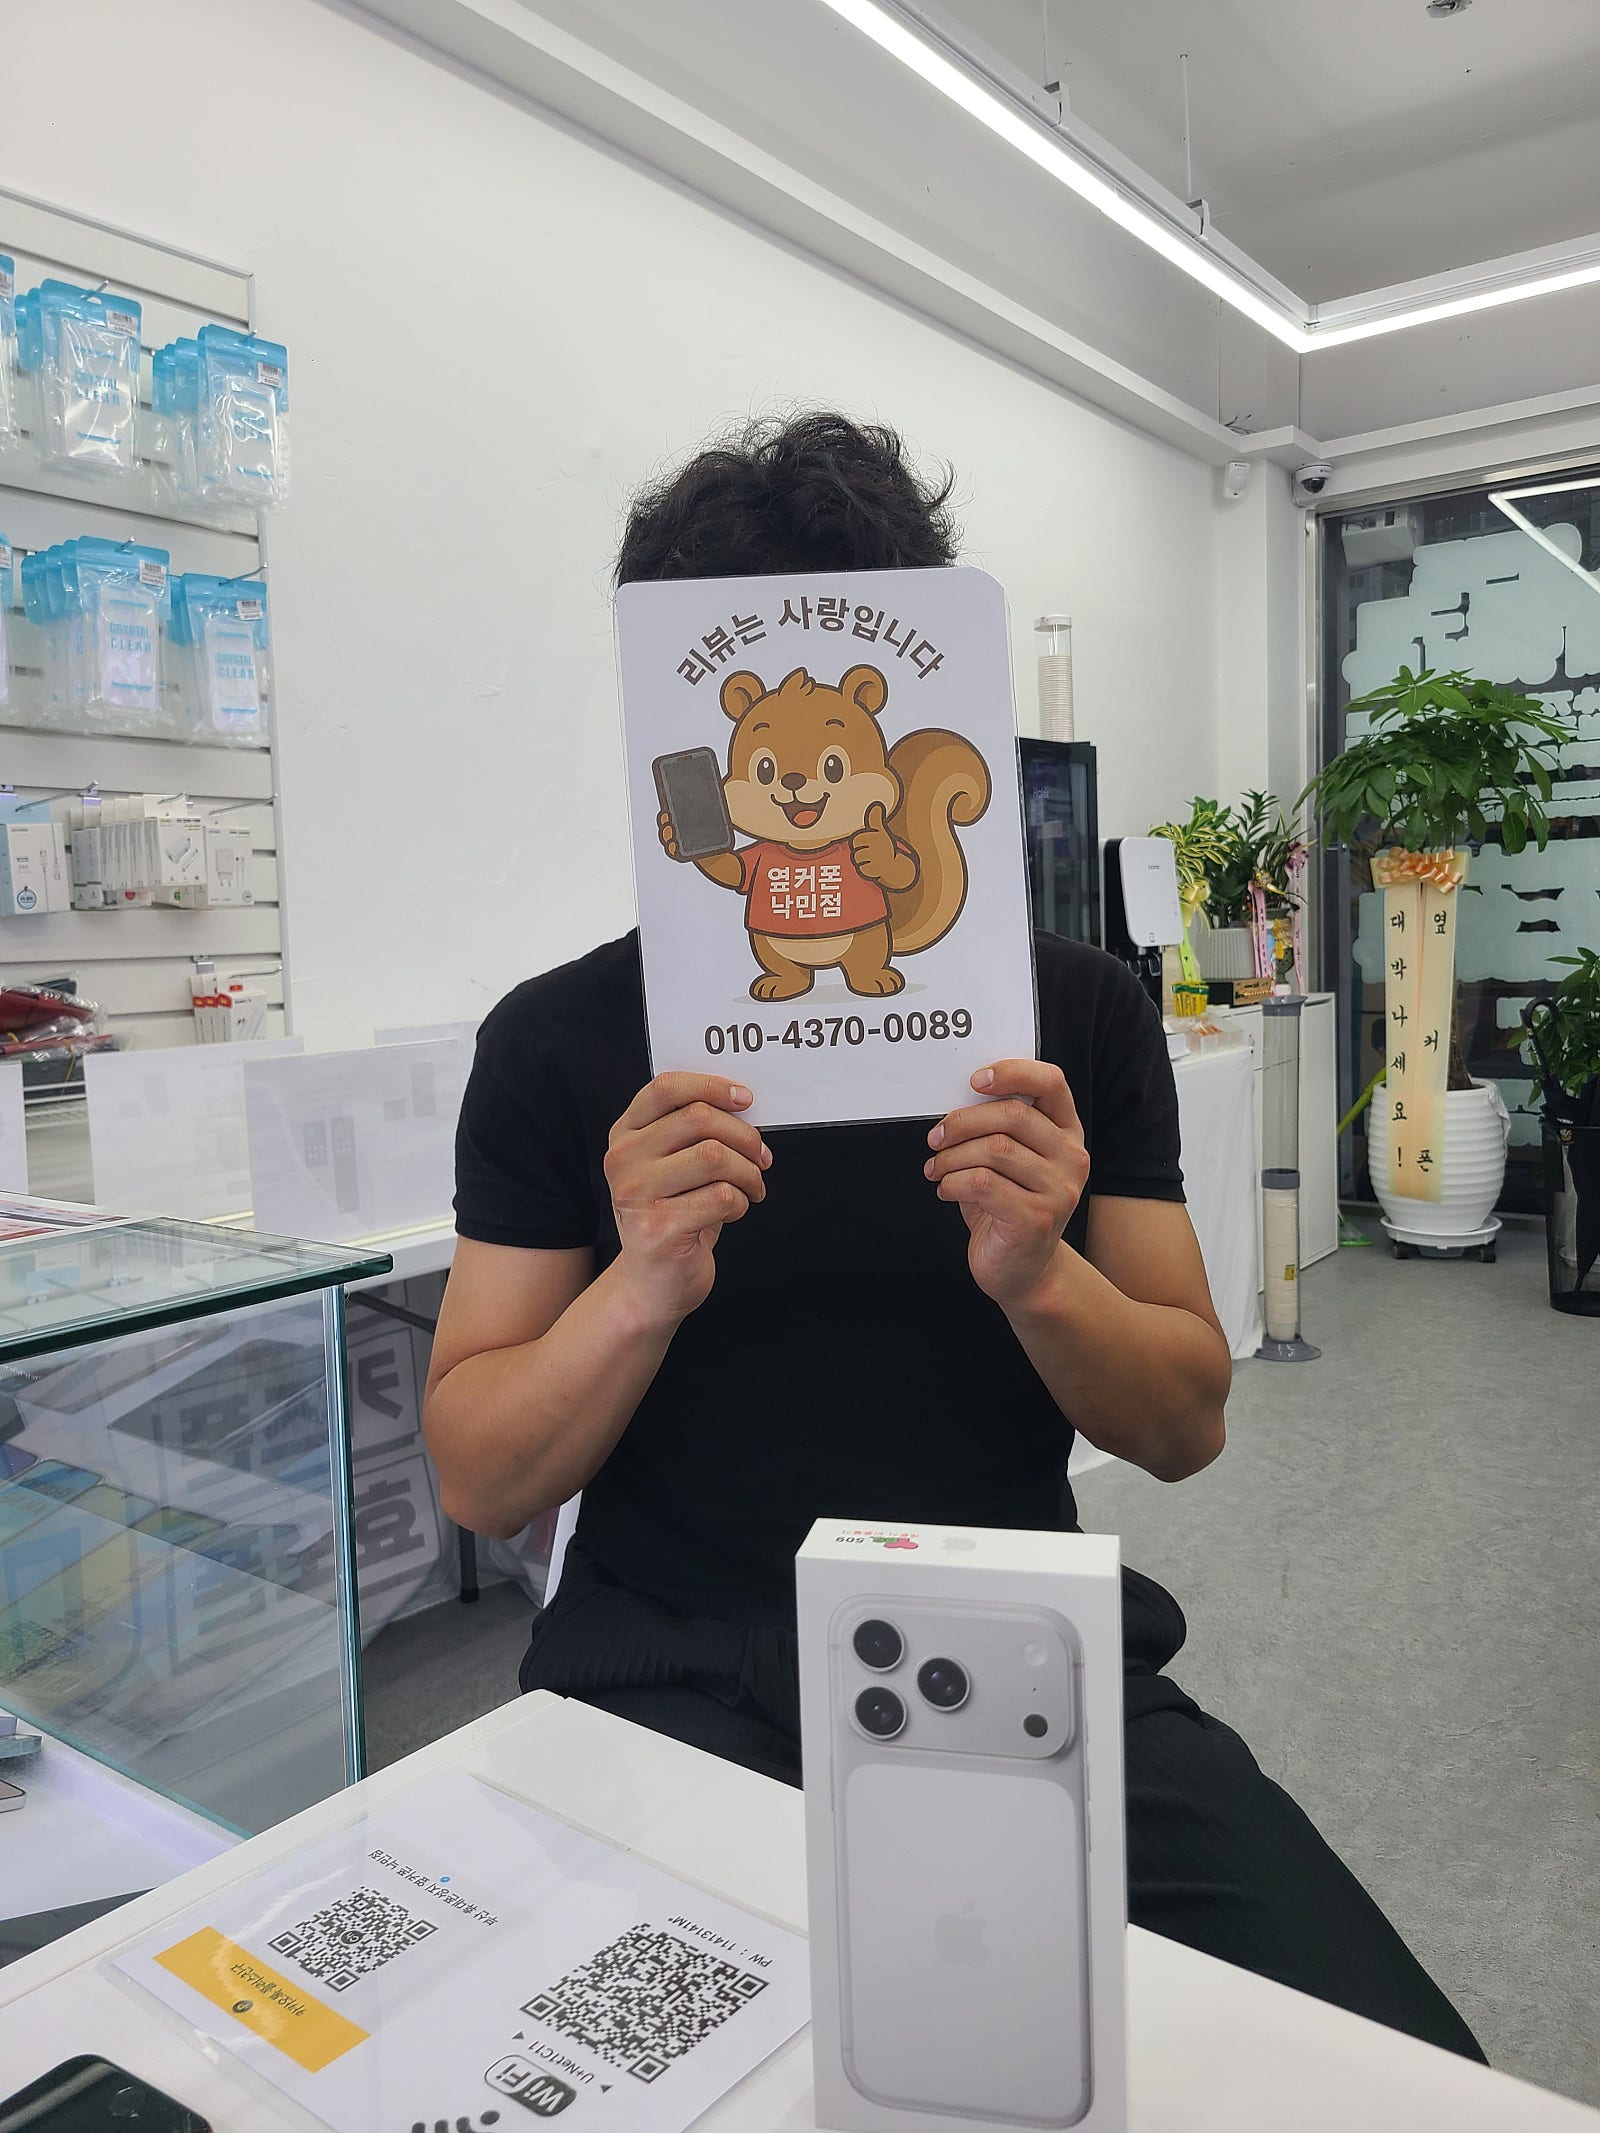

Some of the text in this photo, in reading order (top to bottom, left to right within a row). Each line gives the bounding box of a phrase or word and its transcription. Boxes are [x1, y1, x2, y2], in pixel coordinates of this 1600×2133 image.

[676, 596, 945, 686] 리뷰는 사랑입니다
[767, 864, 843, 893] 옆커폰
[770, 893, 843, 919] 낙민점
[703, 1008, 974, 1056] 010-4370-0089
[1389, 910, 1408, 1169] 대박나세요!
[368, 1849, 399, 1870] 낙민점
[396, 1865, 430, 1888] 옆커폰
[473, 1909, 499, 1926] 부산
[748, 1953, 773, 1968] PW
[230, 1962, 307, 2017] 카카오톡 플러스친구
